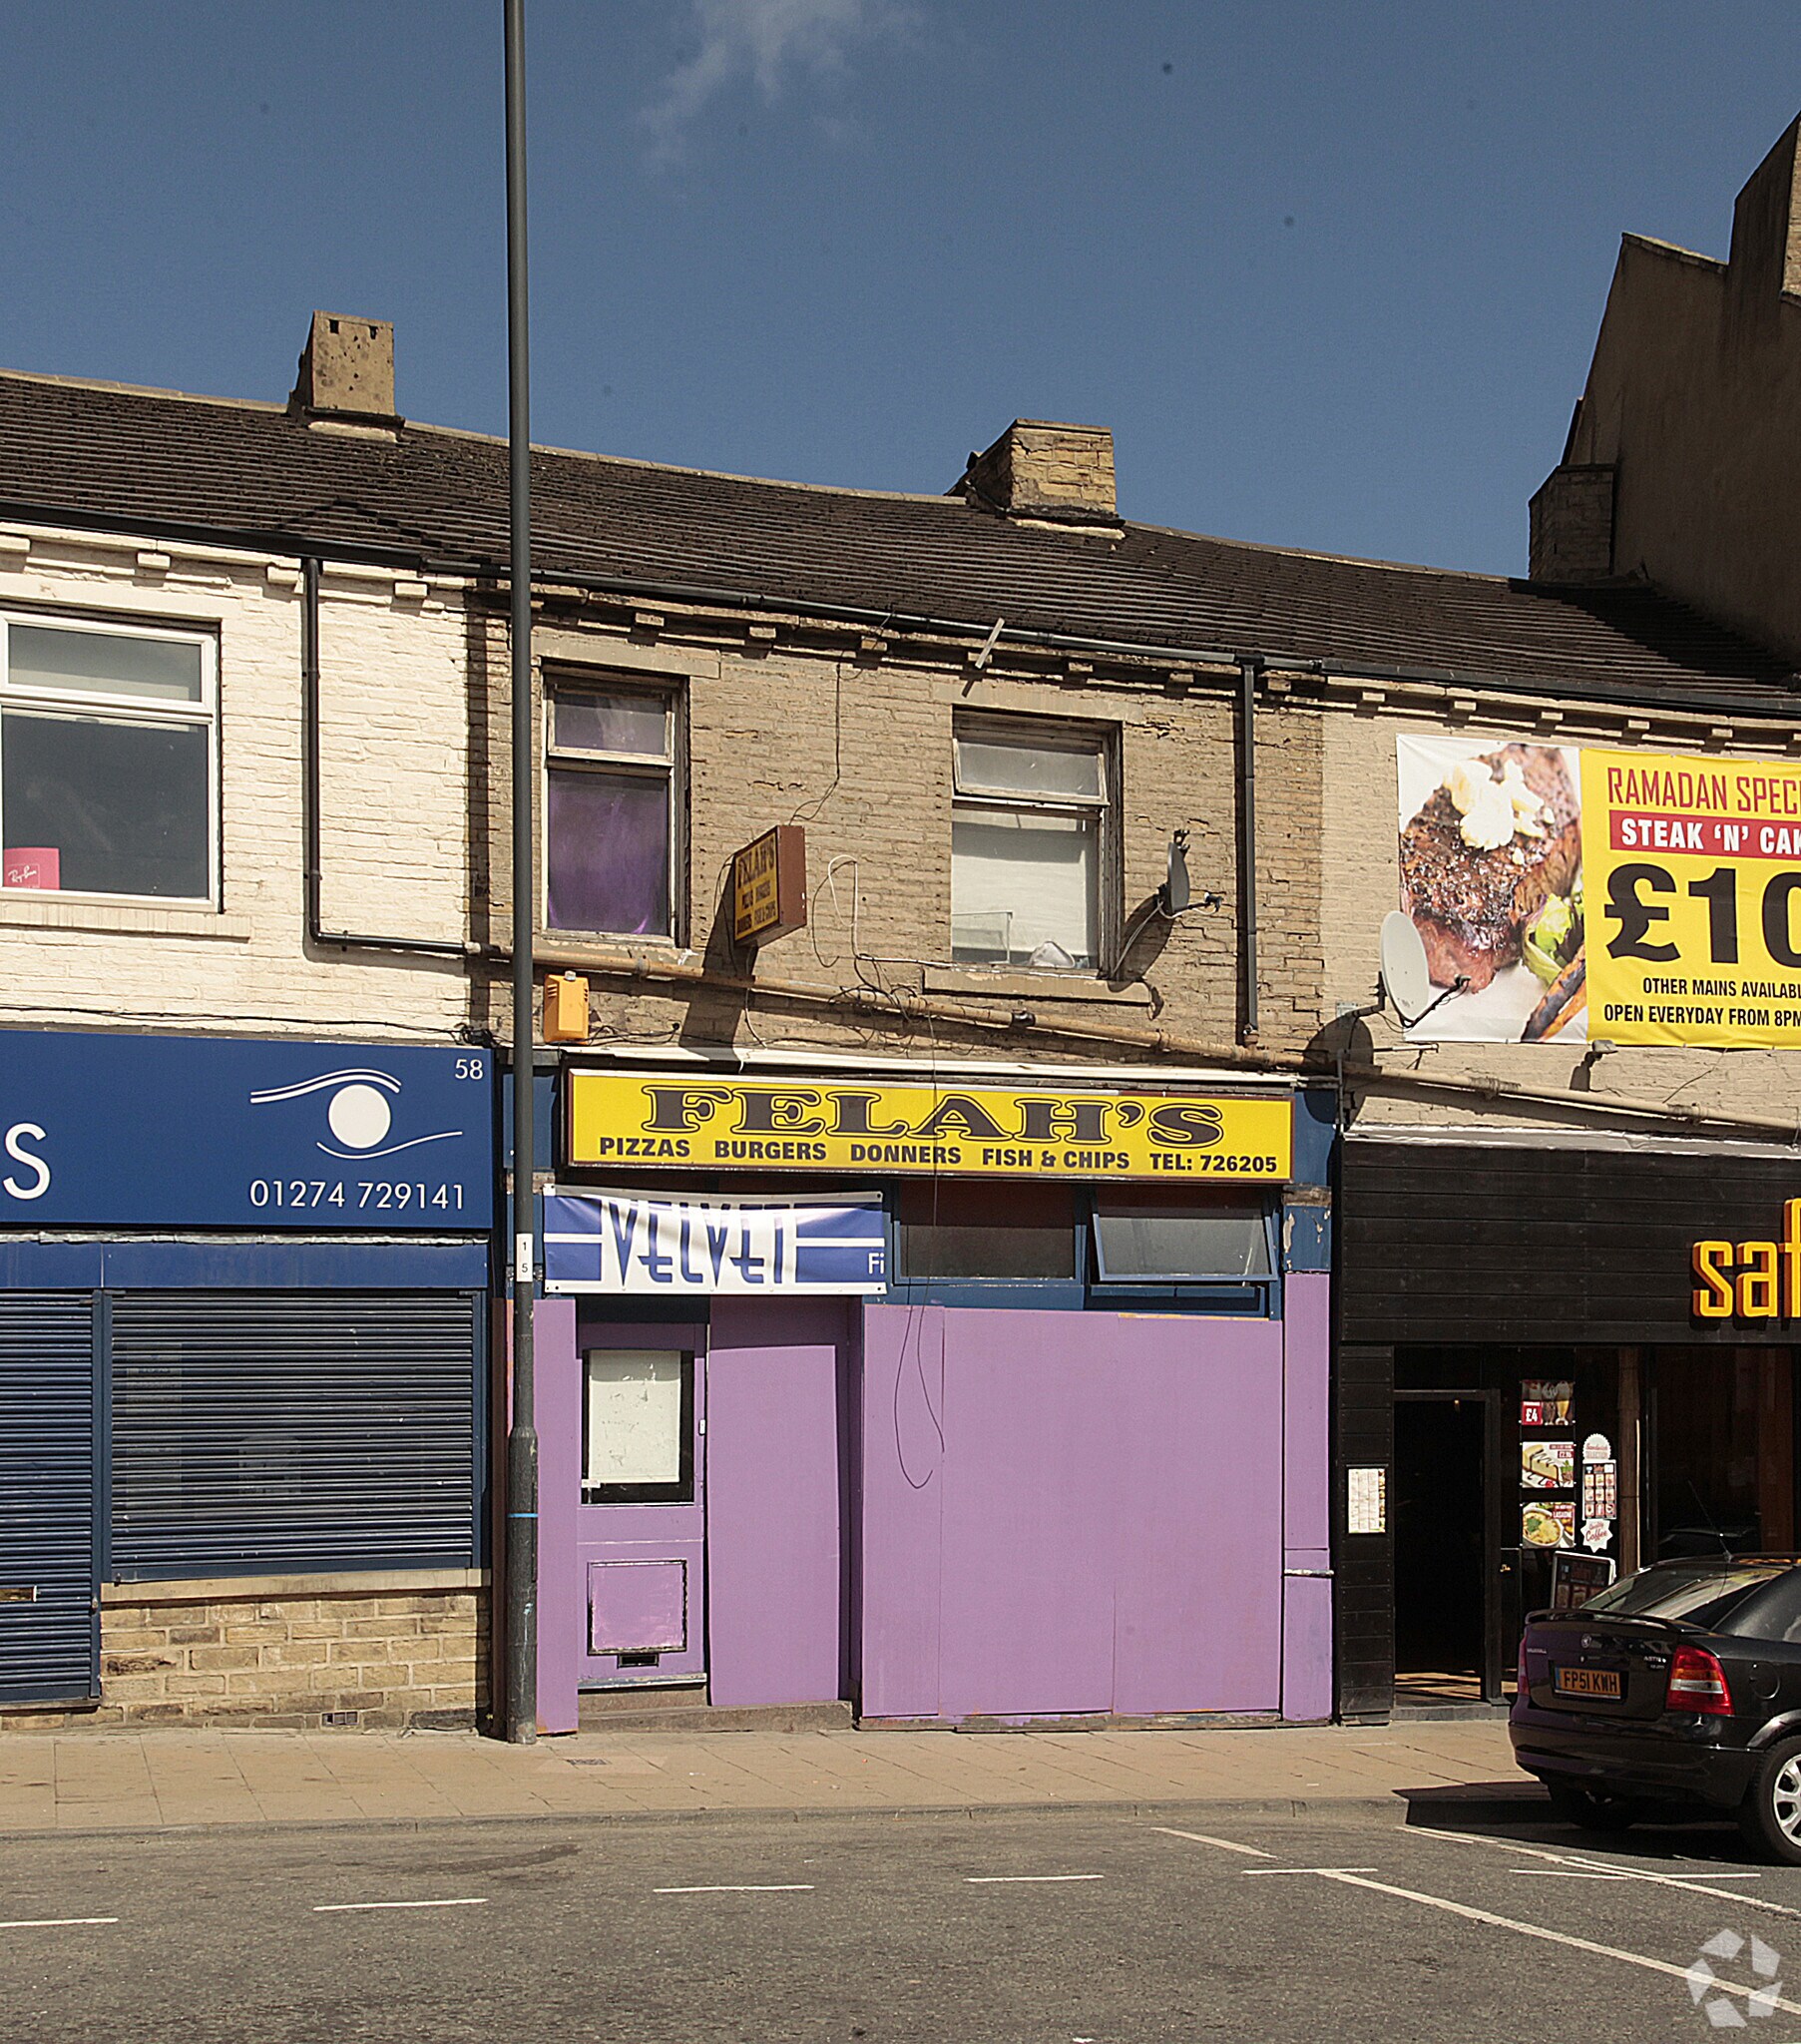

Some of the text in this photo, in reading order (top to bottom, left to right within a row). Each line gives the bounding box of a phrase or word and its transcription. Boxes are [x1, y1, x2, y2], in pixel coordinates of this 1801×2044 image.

[1607, 766, 1728, 810] RAMADAN
[1621, 817, 1703, 849] STEAK
[1603, 862, 1801, 968] £10
[1643, 977, 1686, 995] OTHER
[1692, 979, 1736, 997] MAINS
[1604, 1004, 1643, 1022] OPEN
[1648, 1006, 1723, 1025] EVERYDAY
[1728, 1009, 1769, 1026] FROM
[454, 1059, 483, 1080] 58
[642, 1085, 1223, 1149] FELAH'S
[2, 1123, 51, 1201] S
[600, 1137, 1277, 1173] PIZZAS BURGERS DONNERS FISH & CHIPS TEL: 726205
[250, 1180, 464, 1211] 01274 729141
[868, 1253, 885, 1275] Fi
[1526, 1408, 1538, 1422] £4
[1585, 1529, 1608, 1542] Coffee
[1564, 1671, 1617, 1693] FP51 KWH
